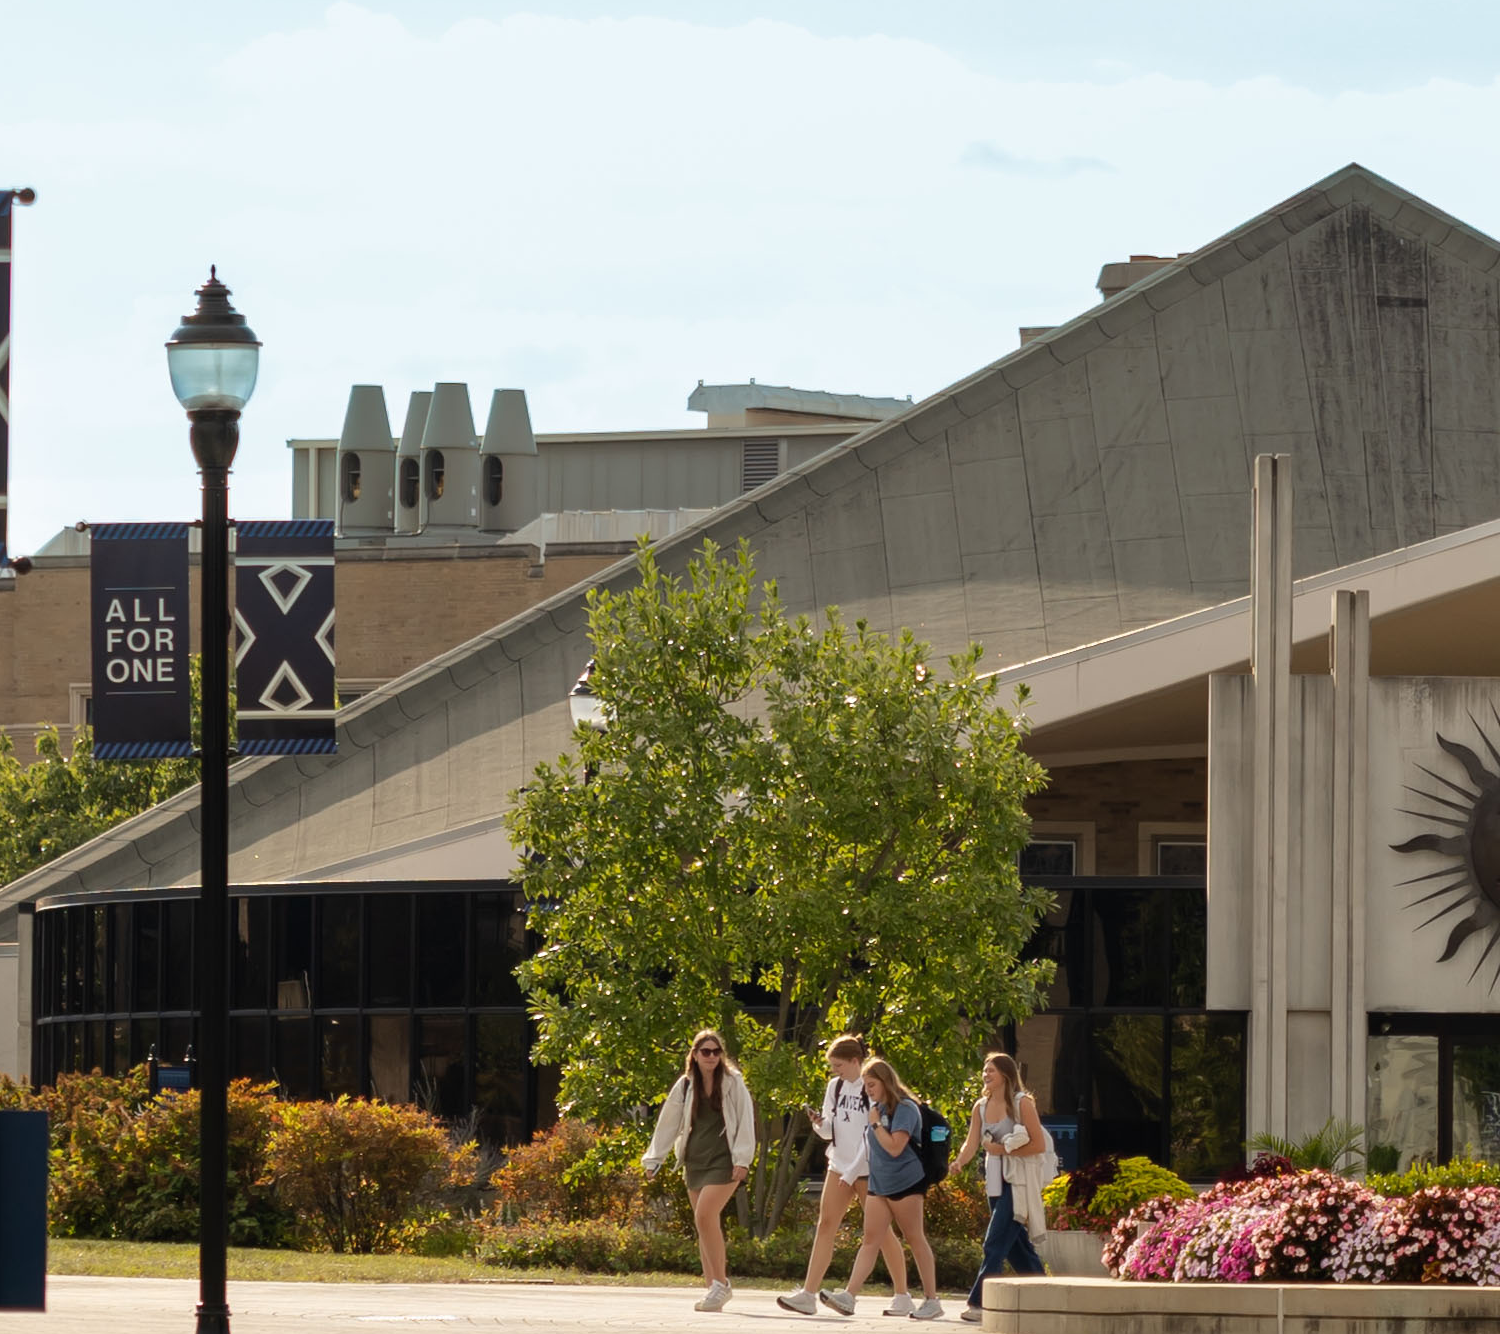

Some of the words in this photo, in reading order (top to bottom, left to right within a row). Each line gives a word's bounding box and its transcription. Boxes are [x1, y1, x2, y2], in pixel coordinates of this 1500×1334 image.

[105, 598, 176, 622] ALL
[106, 628, 174, 652] FOR
[106, 658, 175, 683] ONE
